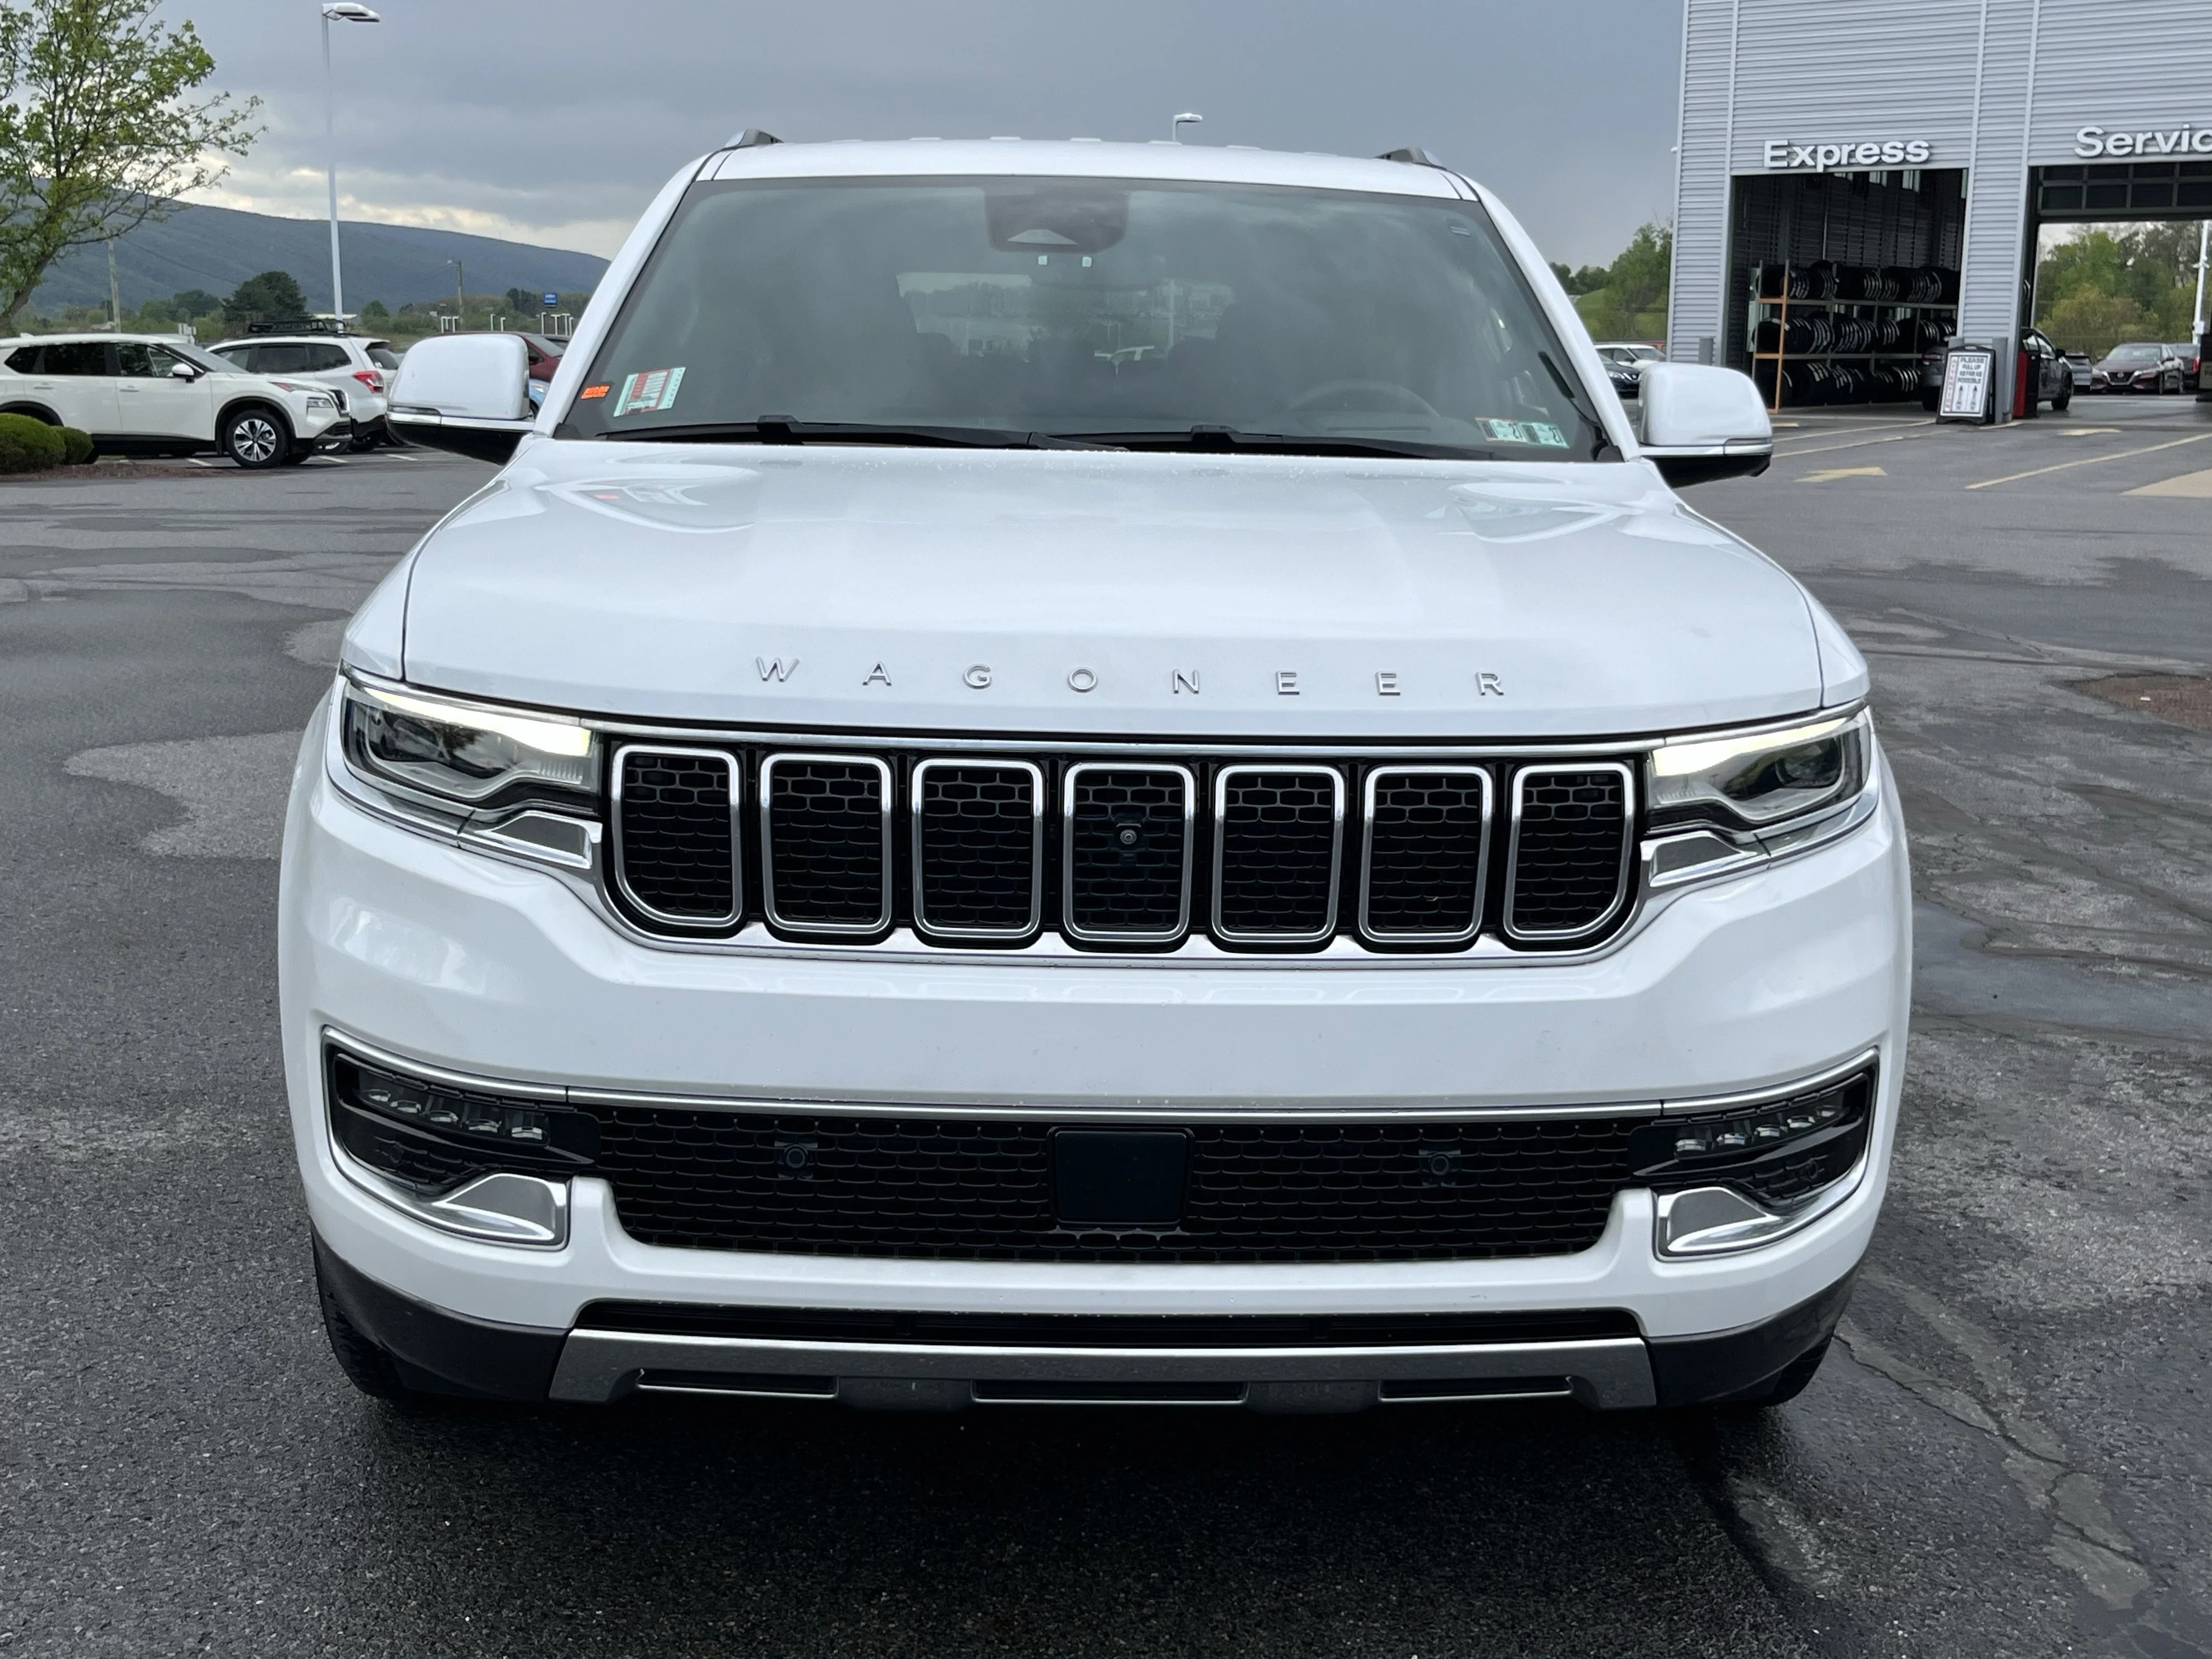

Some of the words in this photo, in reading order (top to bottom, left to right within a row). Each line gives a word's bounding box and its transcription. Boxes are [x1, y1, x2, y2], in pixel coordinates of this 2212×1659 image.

[1763, 139, 1930, 172] Express
[2074, 123, 2212, 158] Servic
[755, 656, 1505, 696] WAGONEER
